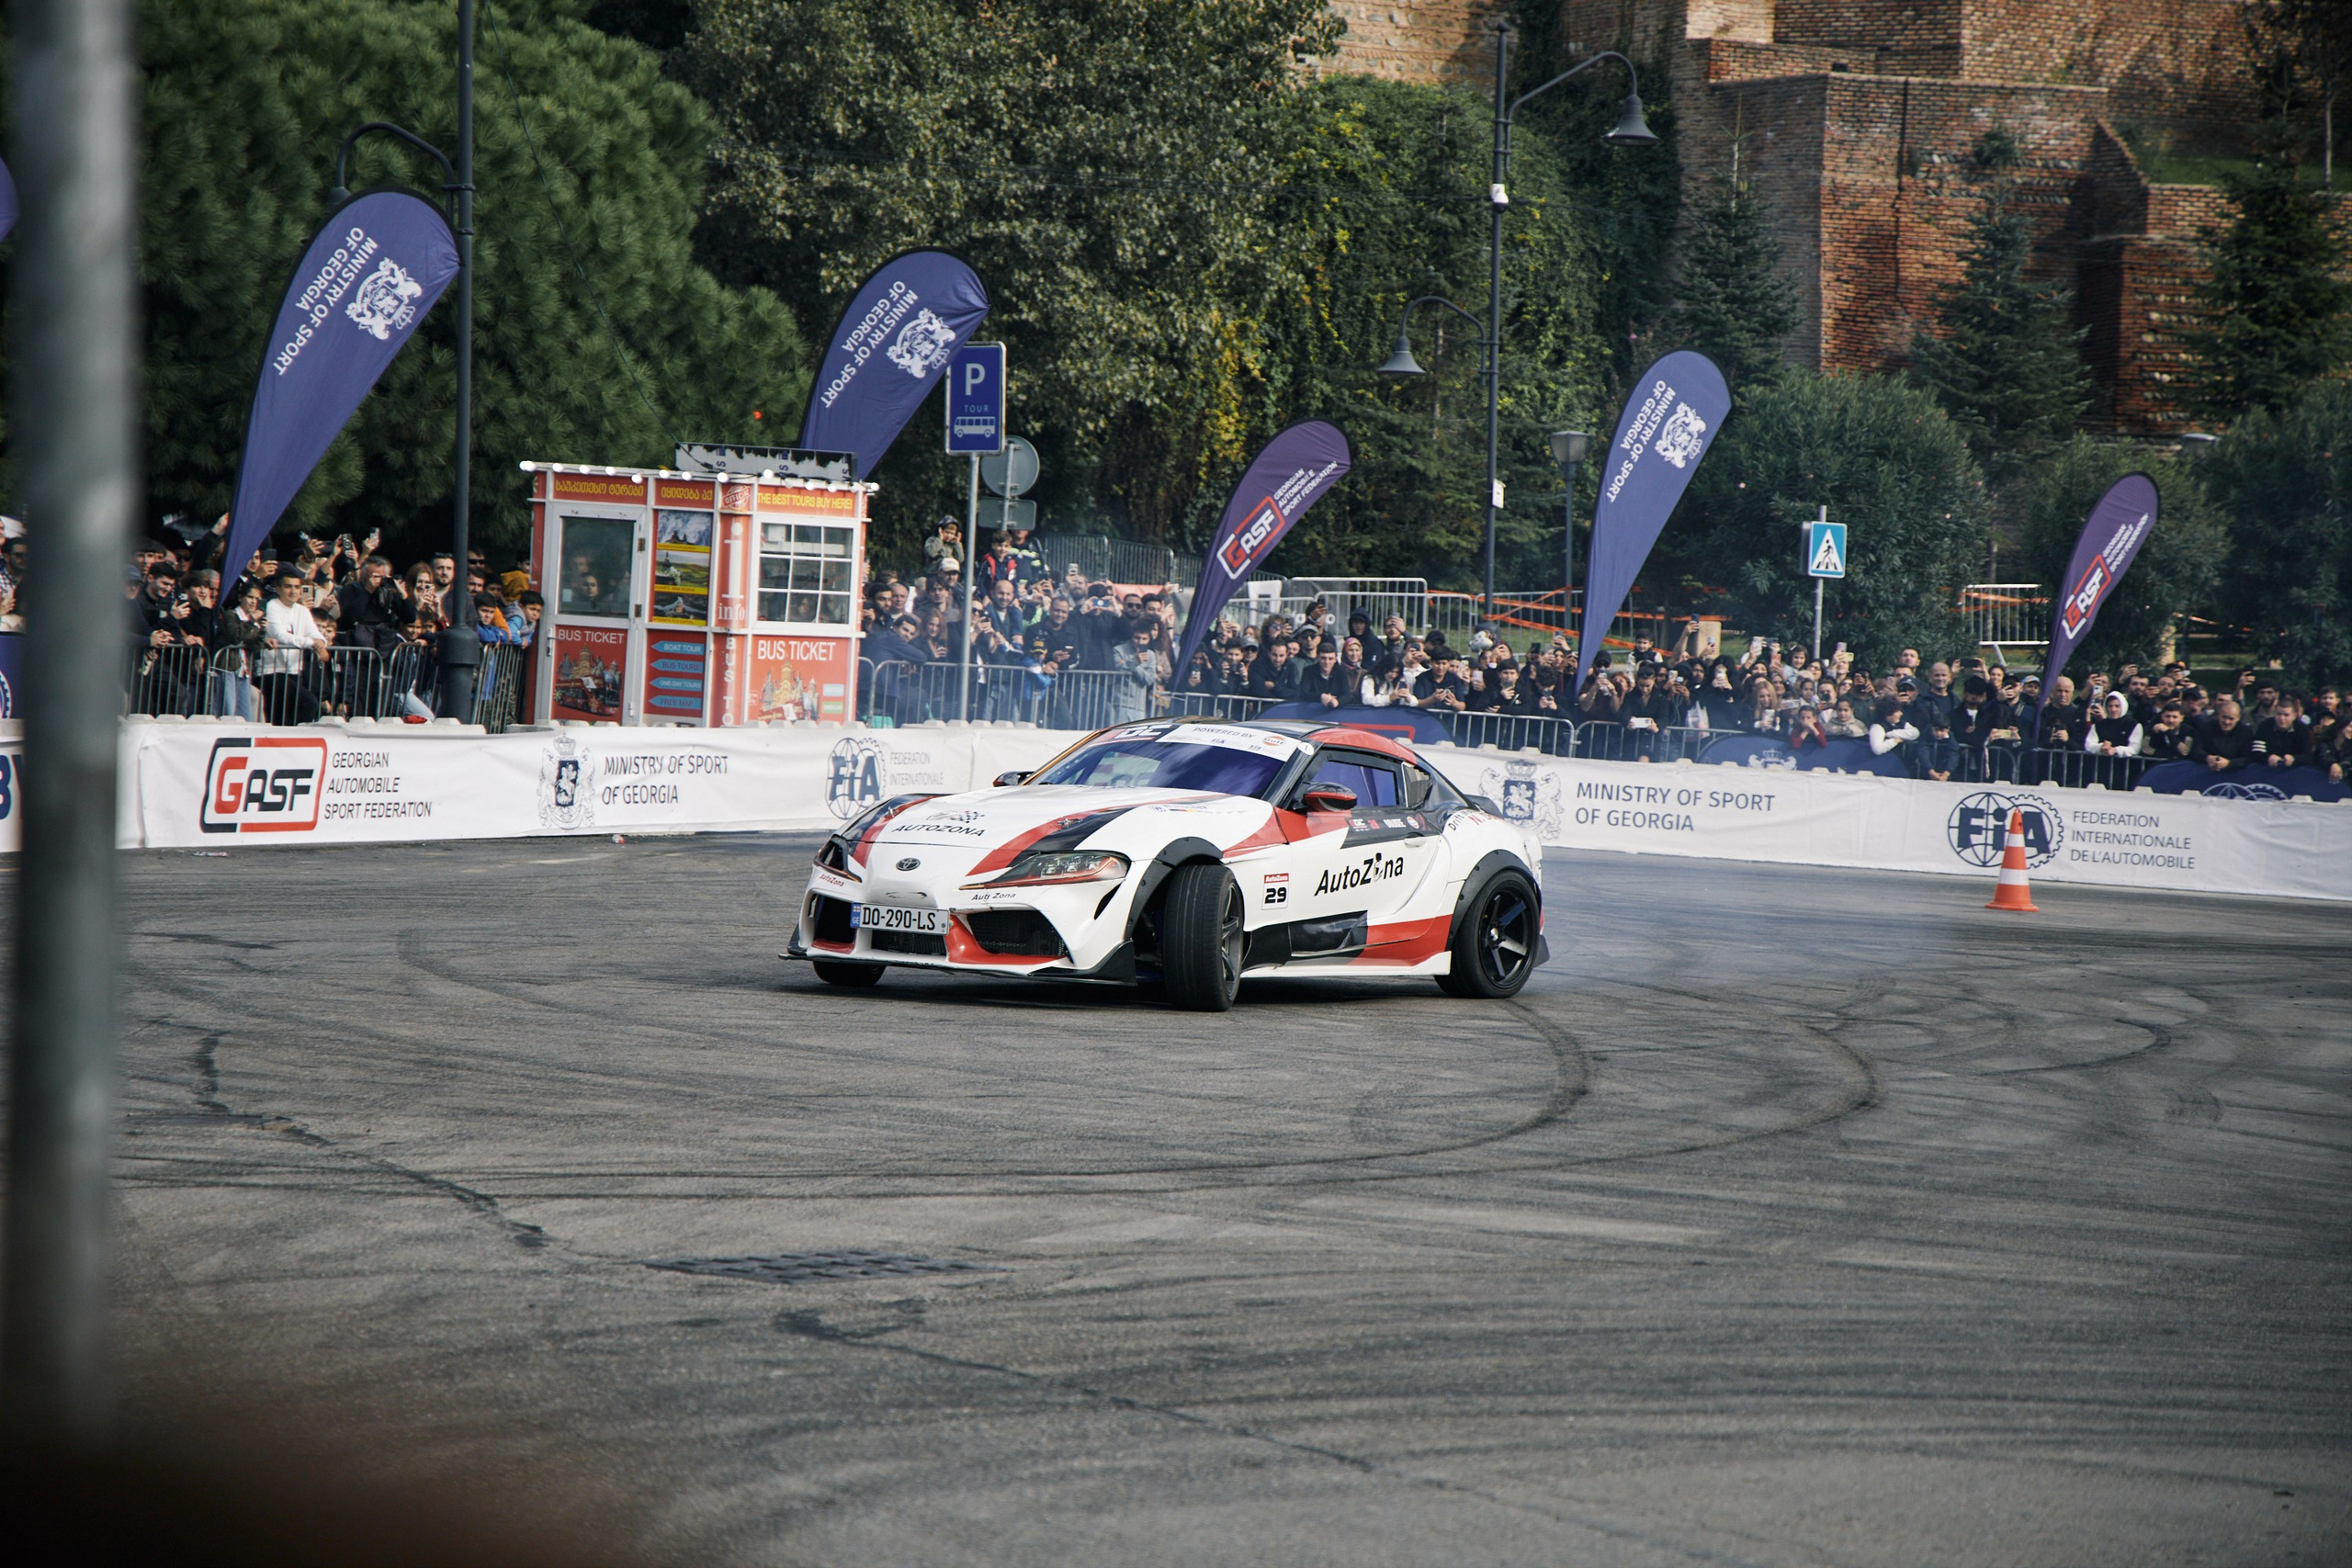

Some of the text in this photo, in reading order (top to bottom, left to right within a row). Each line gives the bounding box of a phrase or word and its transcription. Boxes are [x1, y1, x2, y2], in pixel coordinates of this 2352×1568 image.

[296, 227, 364, 310] OF GEORGIA
[273, 237, 378, 375] MINISTRY OF SPORT
[841, 280, 906, 353] OF GEORGIA
[820, 289, 919, 408] MINISTRY OF SPORT
[966, 363, 986, 396] P
[964, 404, 989, 412] TOUR
[1620, 380, 1667, 450] OF GEORGIA
[1606, 387, 1677, 502] MINISTRY OF SPORT
[608, 483, 644, 497] ტურები
[1273, 468, 1306, 501] GEORGIAN
[1278, 469, 1316, 509] AUTOMOBILE
[1282, 460, 1339, 516] SPORT FEDERATION
[757, 492, 853, 510] THE BEST TOURS BUY HERE!
[1225, 509, 1276, 569] GASF
[2065, 567, 2104, 628] GASF
[718, 603, 745, 622] info
[558, 629, 625, 644] BUS TICKET
[663, 643, 701, 653] BOAT TOUR
[757, 639, 836, 660] BUS TICKET
[662, 661, 700, 671] BUS TOURS
[661, 698, 694, 707] FREE MAP
[1193, 727, 1240, 737] POWERED
[332, 752, 390, 768] GEORGIAN
[604, 754, 729, 775] MINISTRY OF SPORT
[889, 751, 931, 765] FEDERATION
[214, 757, 314, 814] GASF
[327, 777, 400, 794] AUTOMOBILE
[889, 773, 944, 785] INTERNATIONALE
[601, 784, 679, 805] OF GEORGIA
[1576, 783, 1776, 812] MINISTRY OF SPORT
[323, 801, 432, 819] SPORT FEDERATION
[1575, 807, 1695, 831] OF GEORGIA
[2073, 811, 2160, 828] FEDERATION
[891, 824, 986, 837] AUTOZONA
[2071, 830, 2192, 850] INTERNATIONALE
[2070, 850, 2088, 863] DE
[1264, 886, 1287, 904] 29
[852, 916, 860, 925] GE
[862, 906, 936, 931] DO-290-LS
